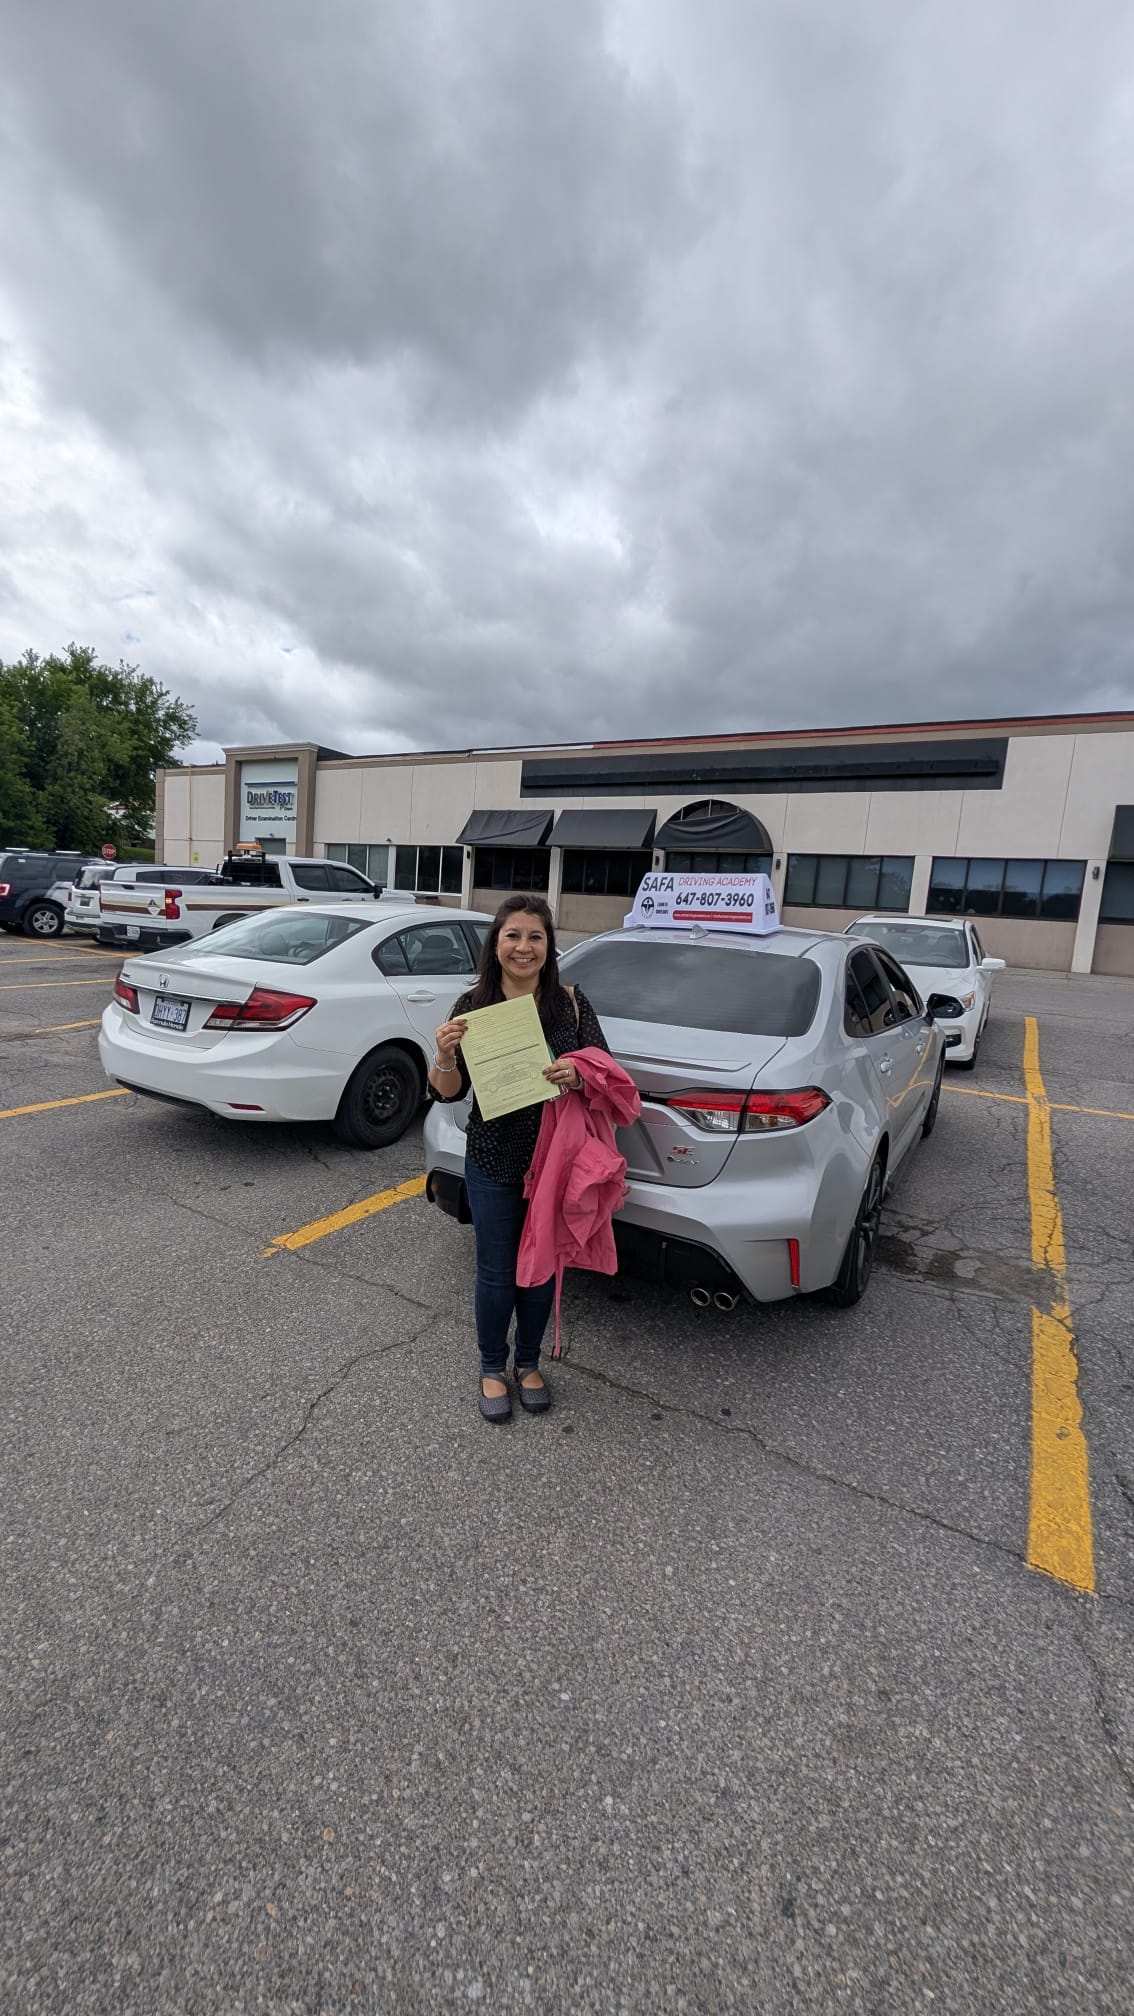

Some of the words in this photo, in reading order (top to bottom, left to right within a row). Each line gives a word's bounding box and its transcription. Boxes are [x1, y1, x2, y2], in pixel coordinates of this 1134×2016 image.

[642, 876, 674, 892] SAFA
[678, 876, 715, 887] DRIVING
[716, 877, 758, 887] ACADEMY
[675, 892, 755, 907] 647-807-3960
